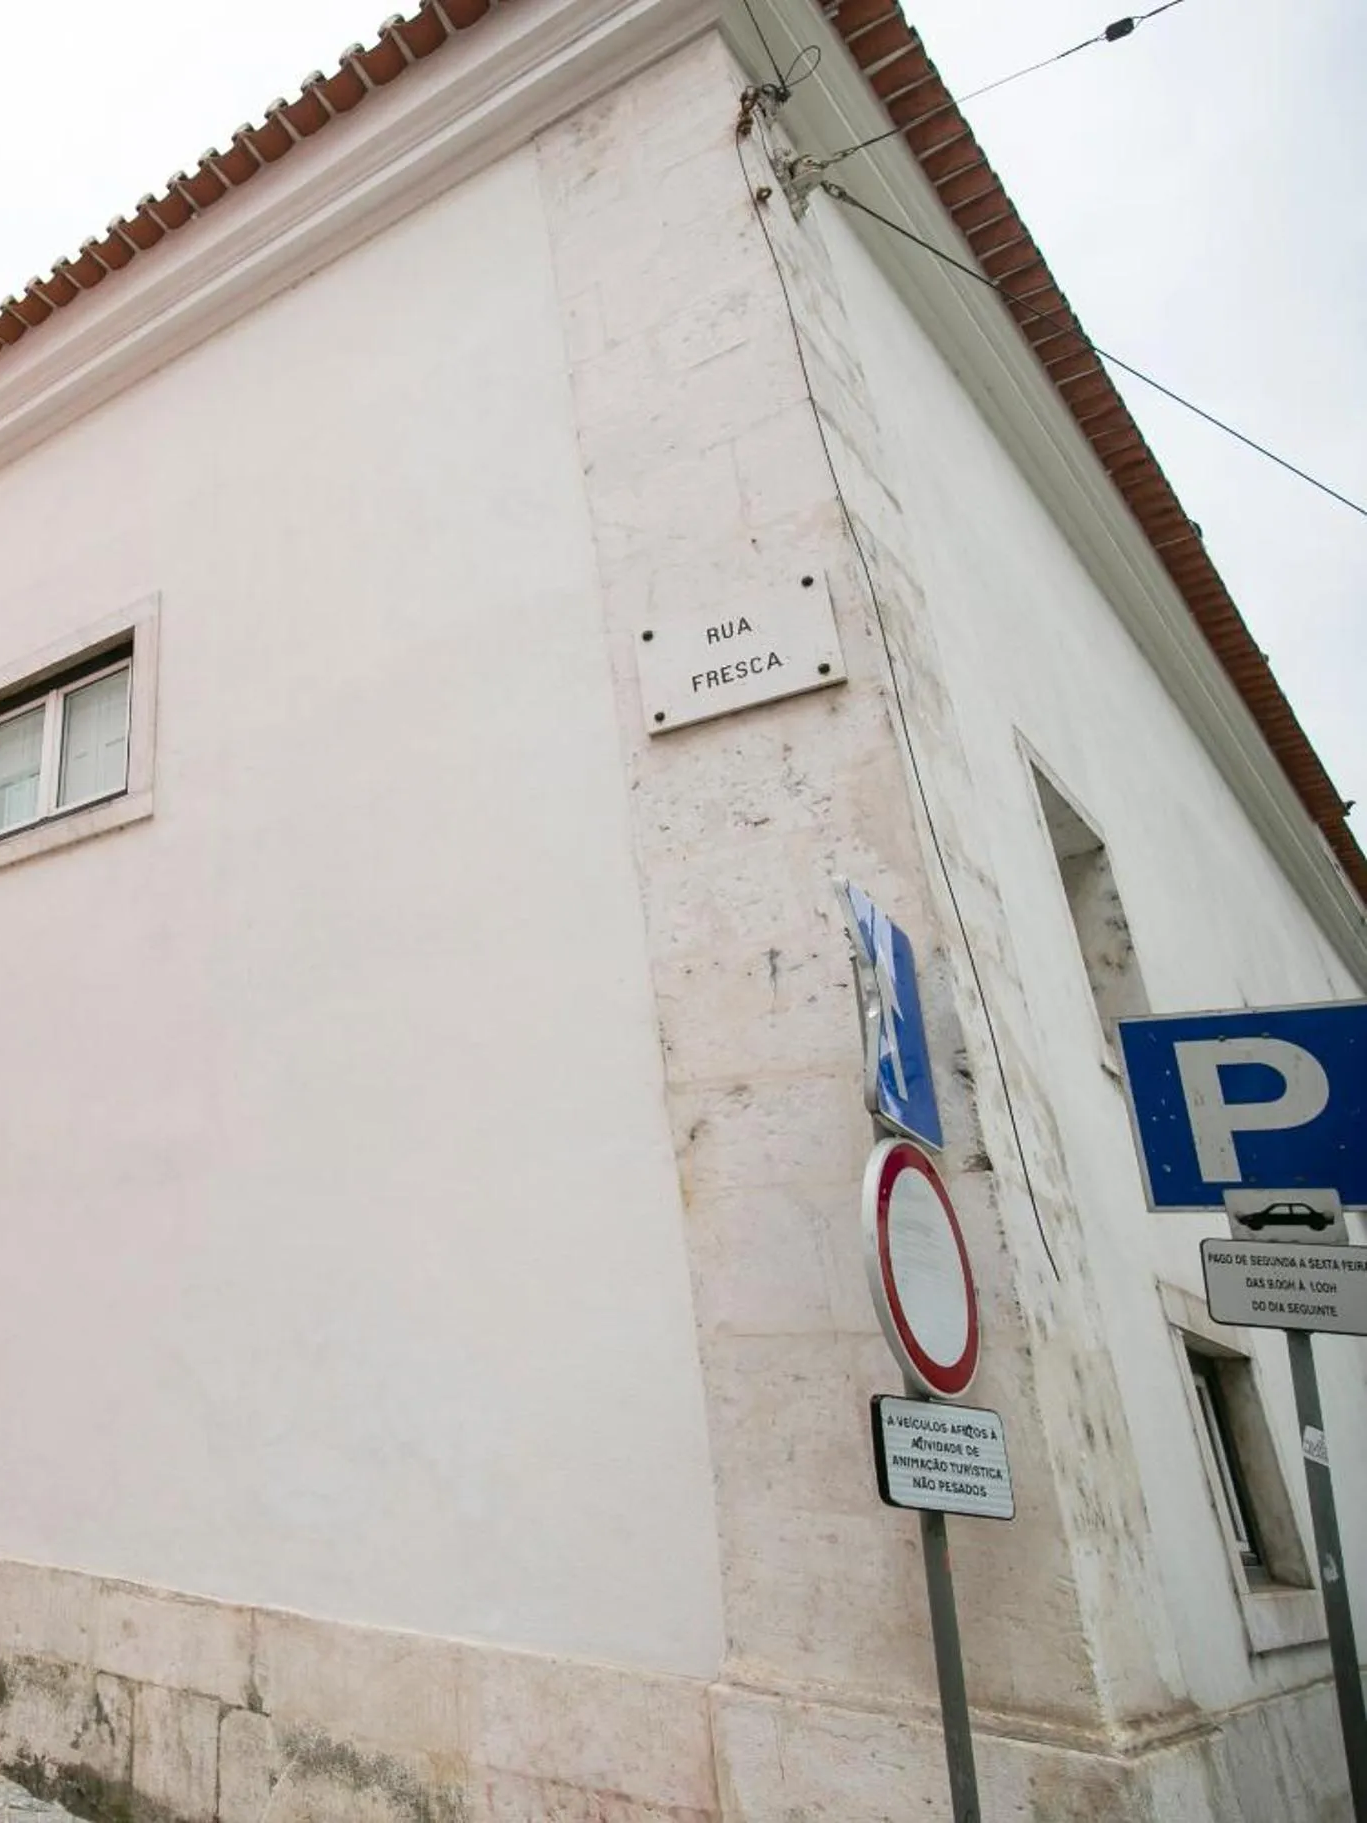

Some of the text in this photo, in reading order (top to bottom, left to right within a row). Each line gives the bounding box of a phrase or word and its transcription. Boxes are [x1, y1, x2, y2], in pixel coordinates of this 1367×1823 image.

[706, 617, 753, 645] RUA
[691, 652, 783, 692] FRESCA
[1173, 1037, 1330, 1183] P
[1208, 1252, 1233, 1265] PAGO
[1235, 1253, 1249, 1266] DE
[1250, 1254, 1297, 1268] SEGUNDA
[1308, 1257, 1340, 1270] SEXTA
[1246, 1277, 1266, 1289] DAS
[1252, 1300, 1339, 1317] DO DIA SEGUINTE
[896, 1415, 948, 1434] VEÍCULOS
[965, 1444, 980, 1458] DE
[892, 1455, 1003, 1481] ANIMAÇÃO TURÍSTICA
[912, 1476, 988, 1498] NÃO PESADOS
